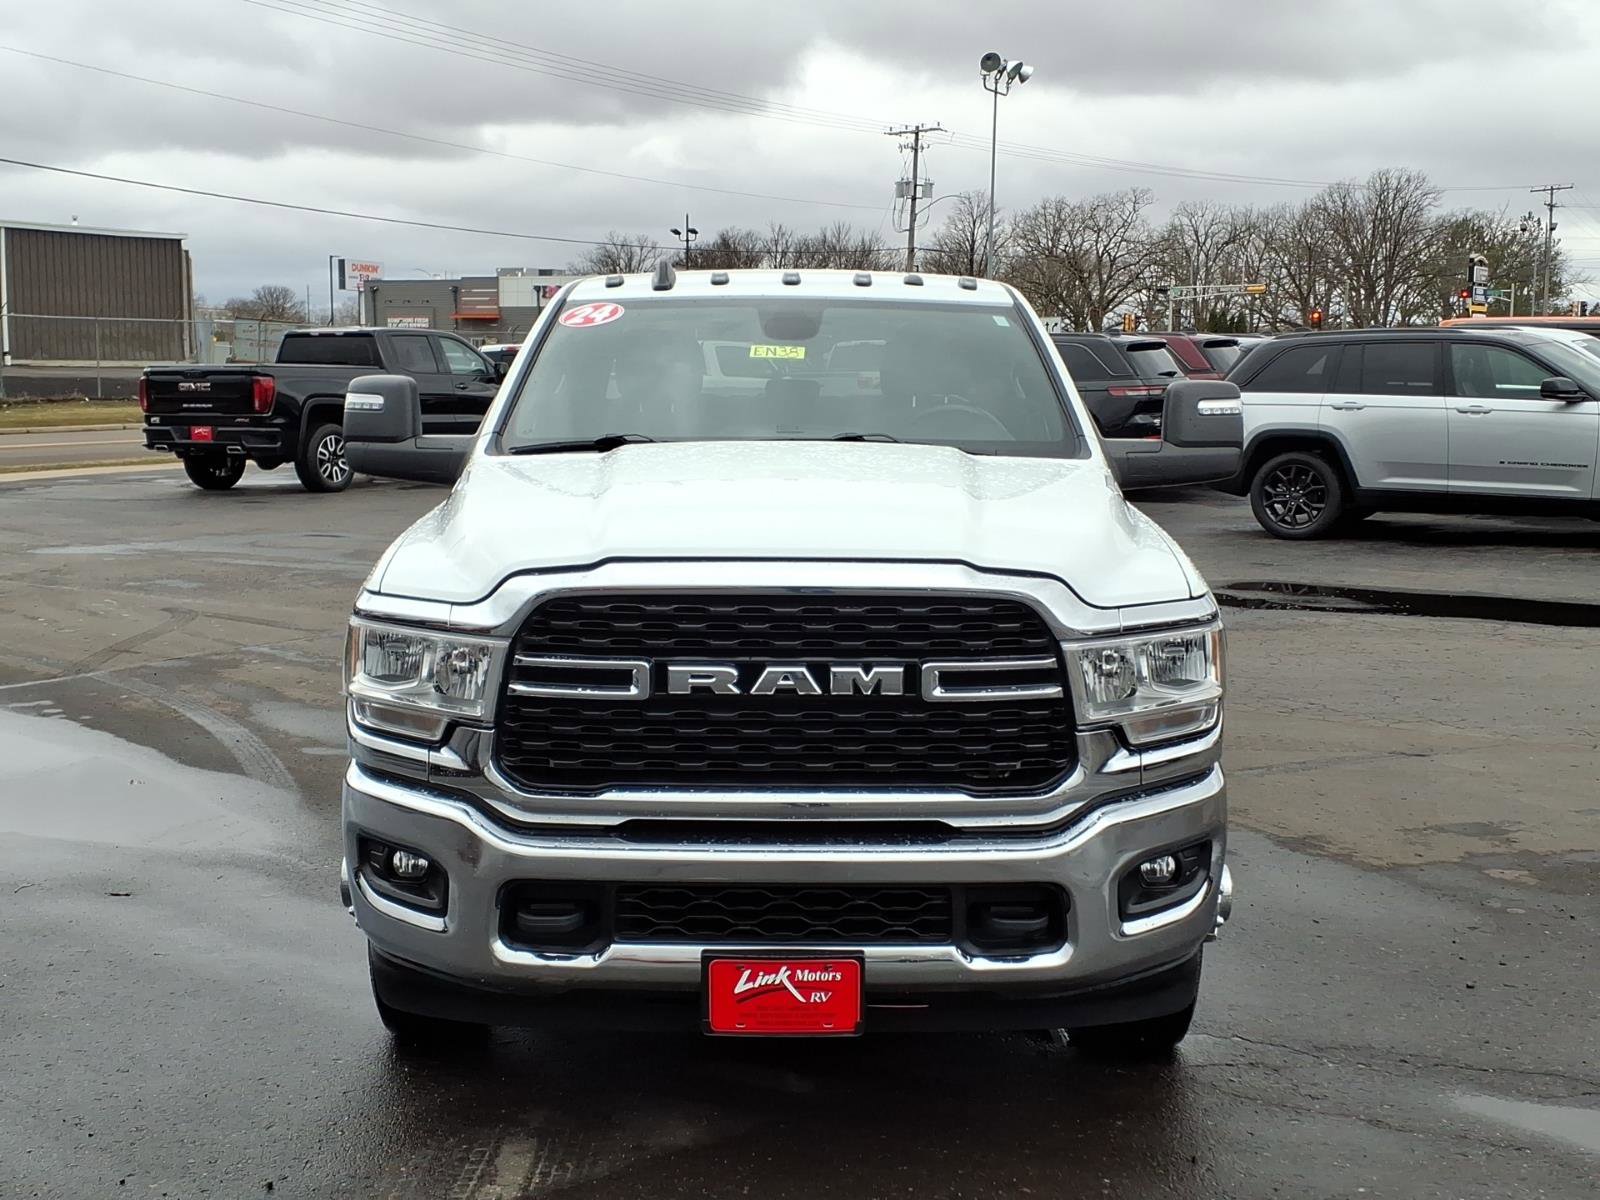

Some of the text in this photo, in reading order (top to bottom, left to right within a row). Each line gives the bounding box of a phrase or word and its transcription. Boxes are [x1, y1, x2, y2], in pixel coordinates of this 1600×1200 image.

[178, 382, 211, 391] GMC
[667, 666, 904, 695] RAM
[734, 965, 842, 1003] Link Motors
[810, 991, 832, 1003] RV
